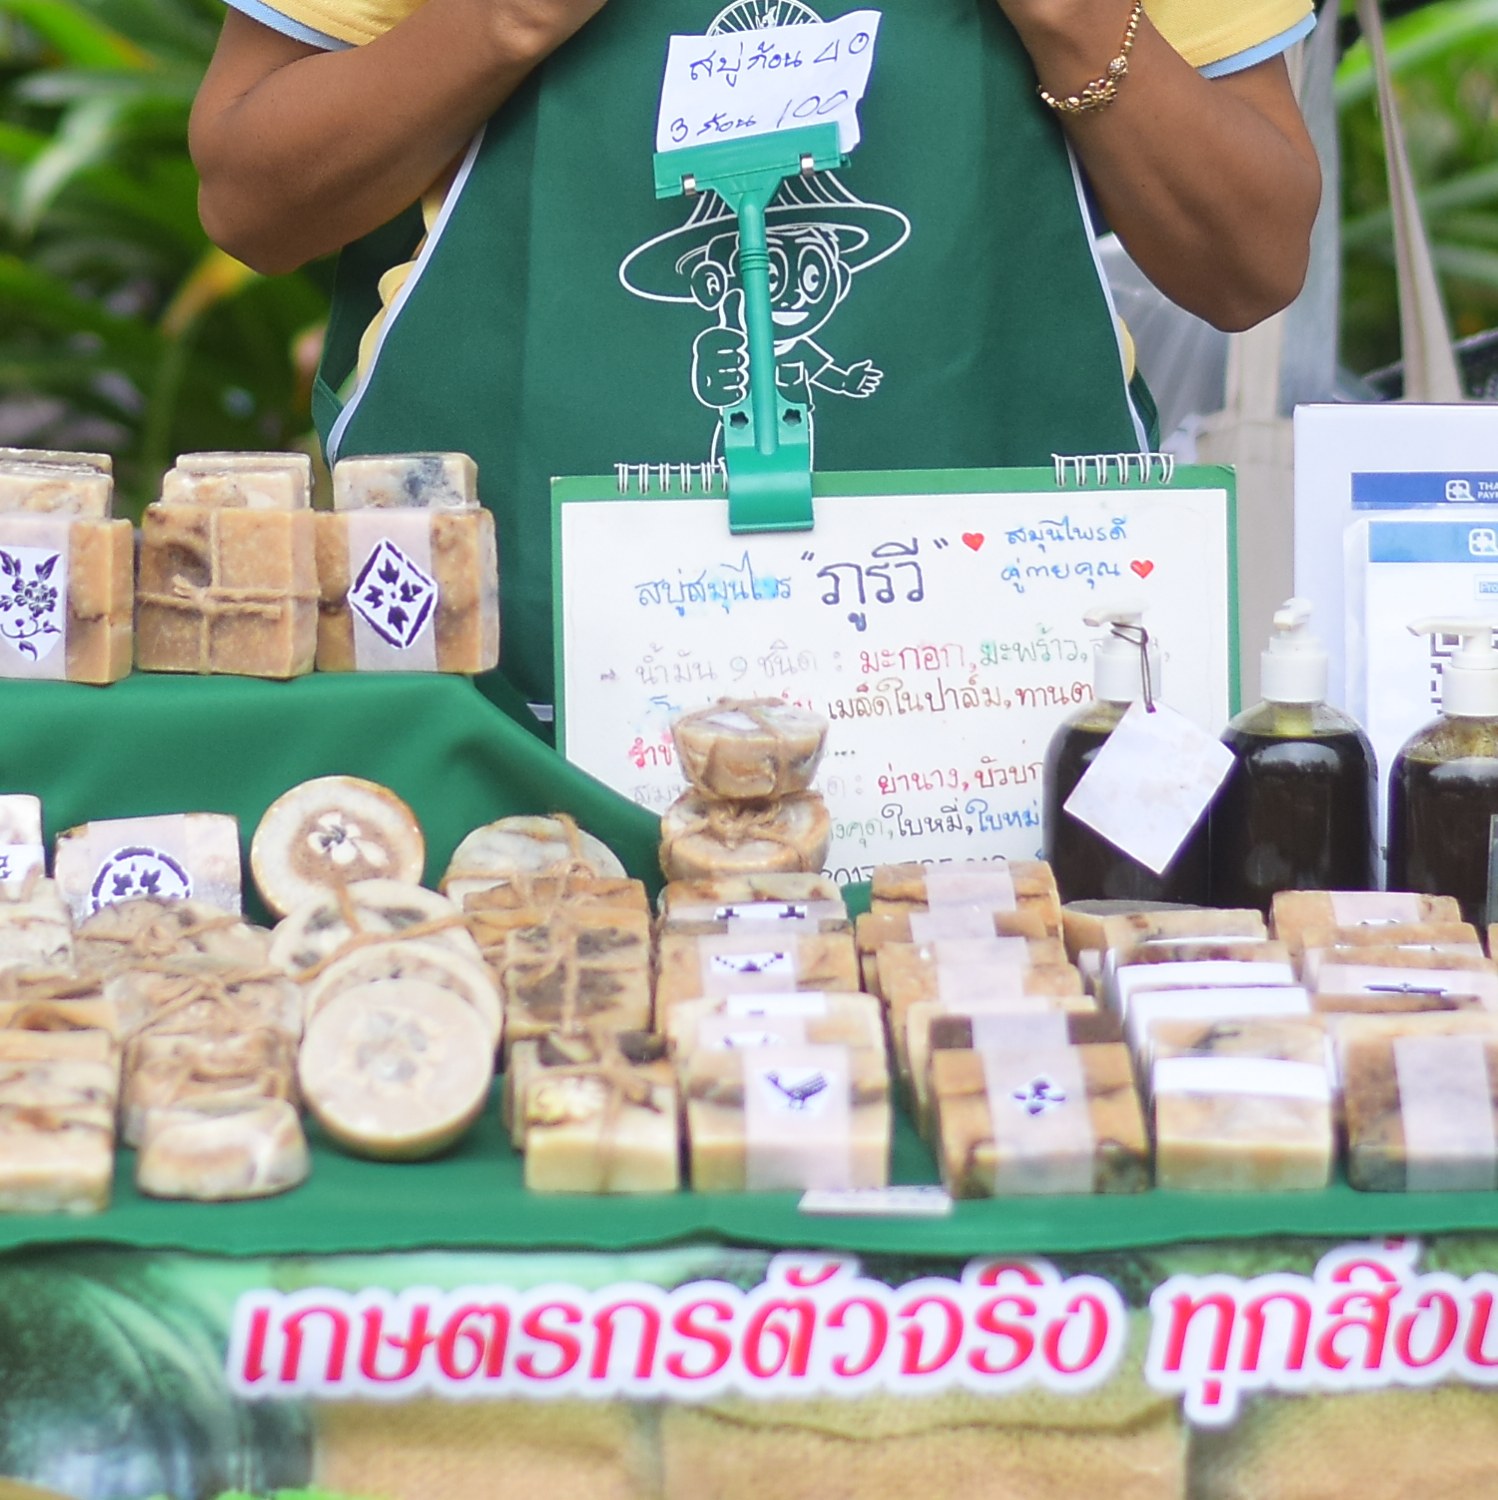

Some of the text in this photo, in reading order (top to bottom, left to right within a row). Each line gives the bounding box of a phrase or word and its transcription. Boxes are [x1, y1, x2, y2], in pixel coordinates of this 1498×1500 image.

[813, 31, 870, 64] 40
[670, 117, 689, 143] 3
[776, 90, 849, 129] 100
[634, 551, 792, 617] สบู่สมุนไร
[244, 1260, 1111, 1384] เกษตรกรตัวจริง
